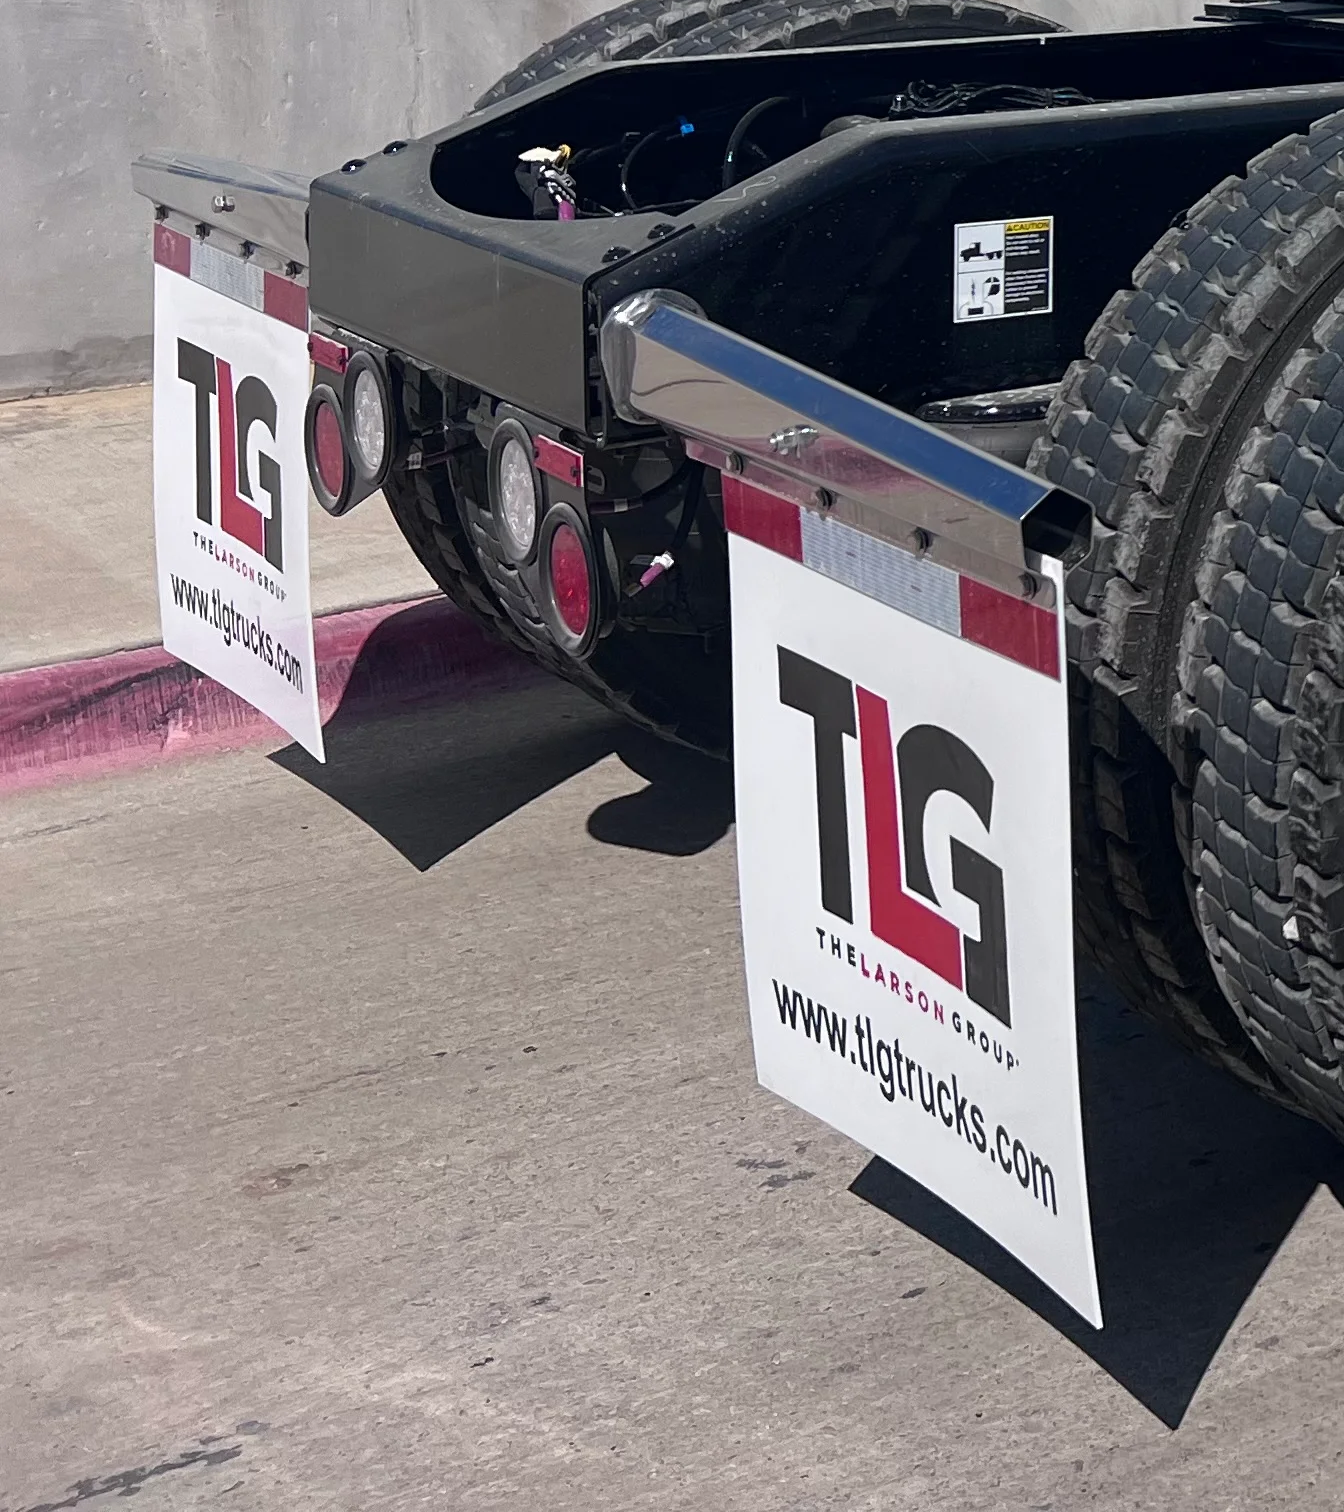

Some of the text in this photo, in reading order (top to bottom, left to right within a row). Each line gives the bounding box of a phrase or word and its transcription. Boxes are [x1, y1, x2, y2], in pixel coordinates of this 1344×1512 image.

[1013, 222, 1048, 232] CAUTION
[177, 337, 284, 574] TLG
[169, 572, 304, 694] www.tlgtrucks.com
[257, 571, 285, 603] GROUP
[776, 644, 1012, 1029] TLG
[772, 978, 1058, 1216] www.tlgtrucks.com
[952, 1011, 1015, 1071] GROUP
